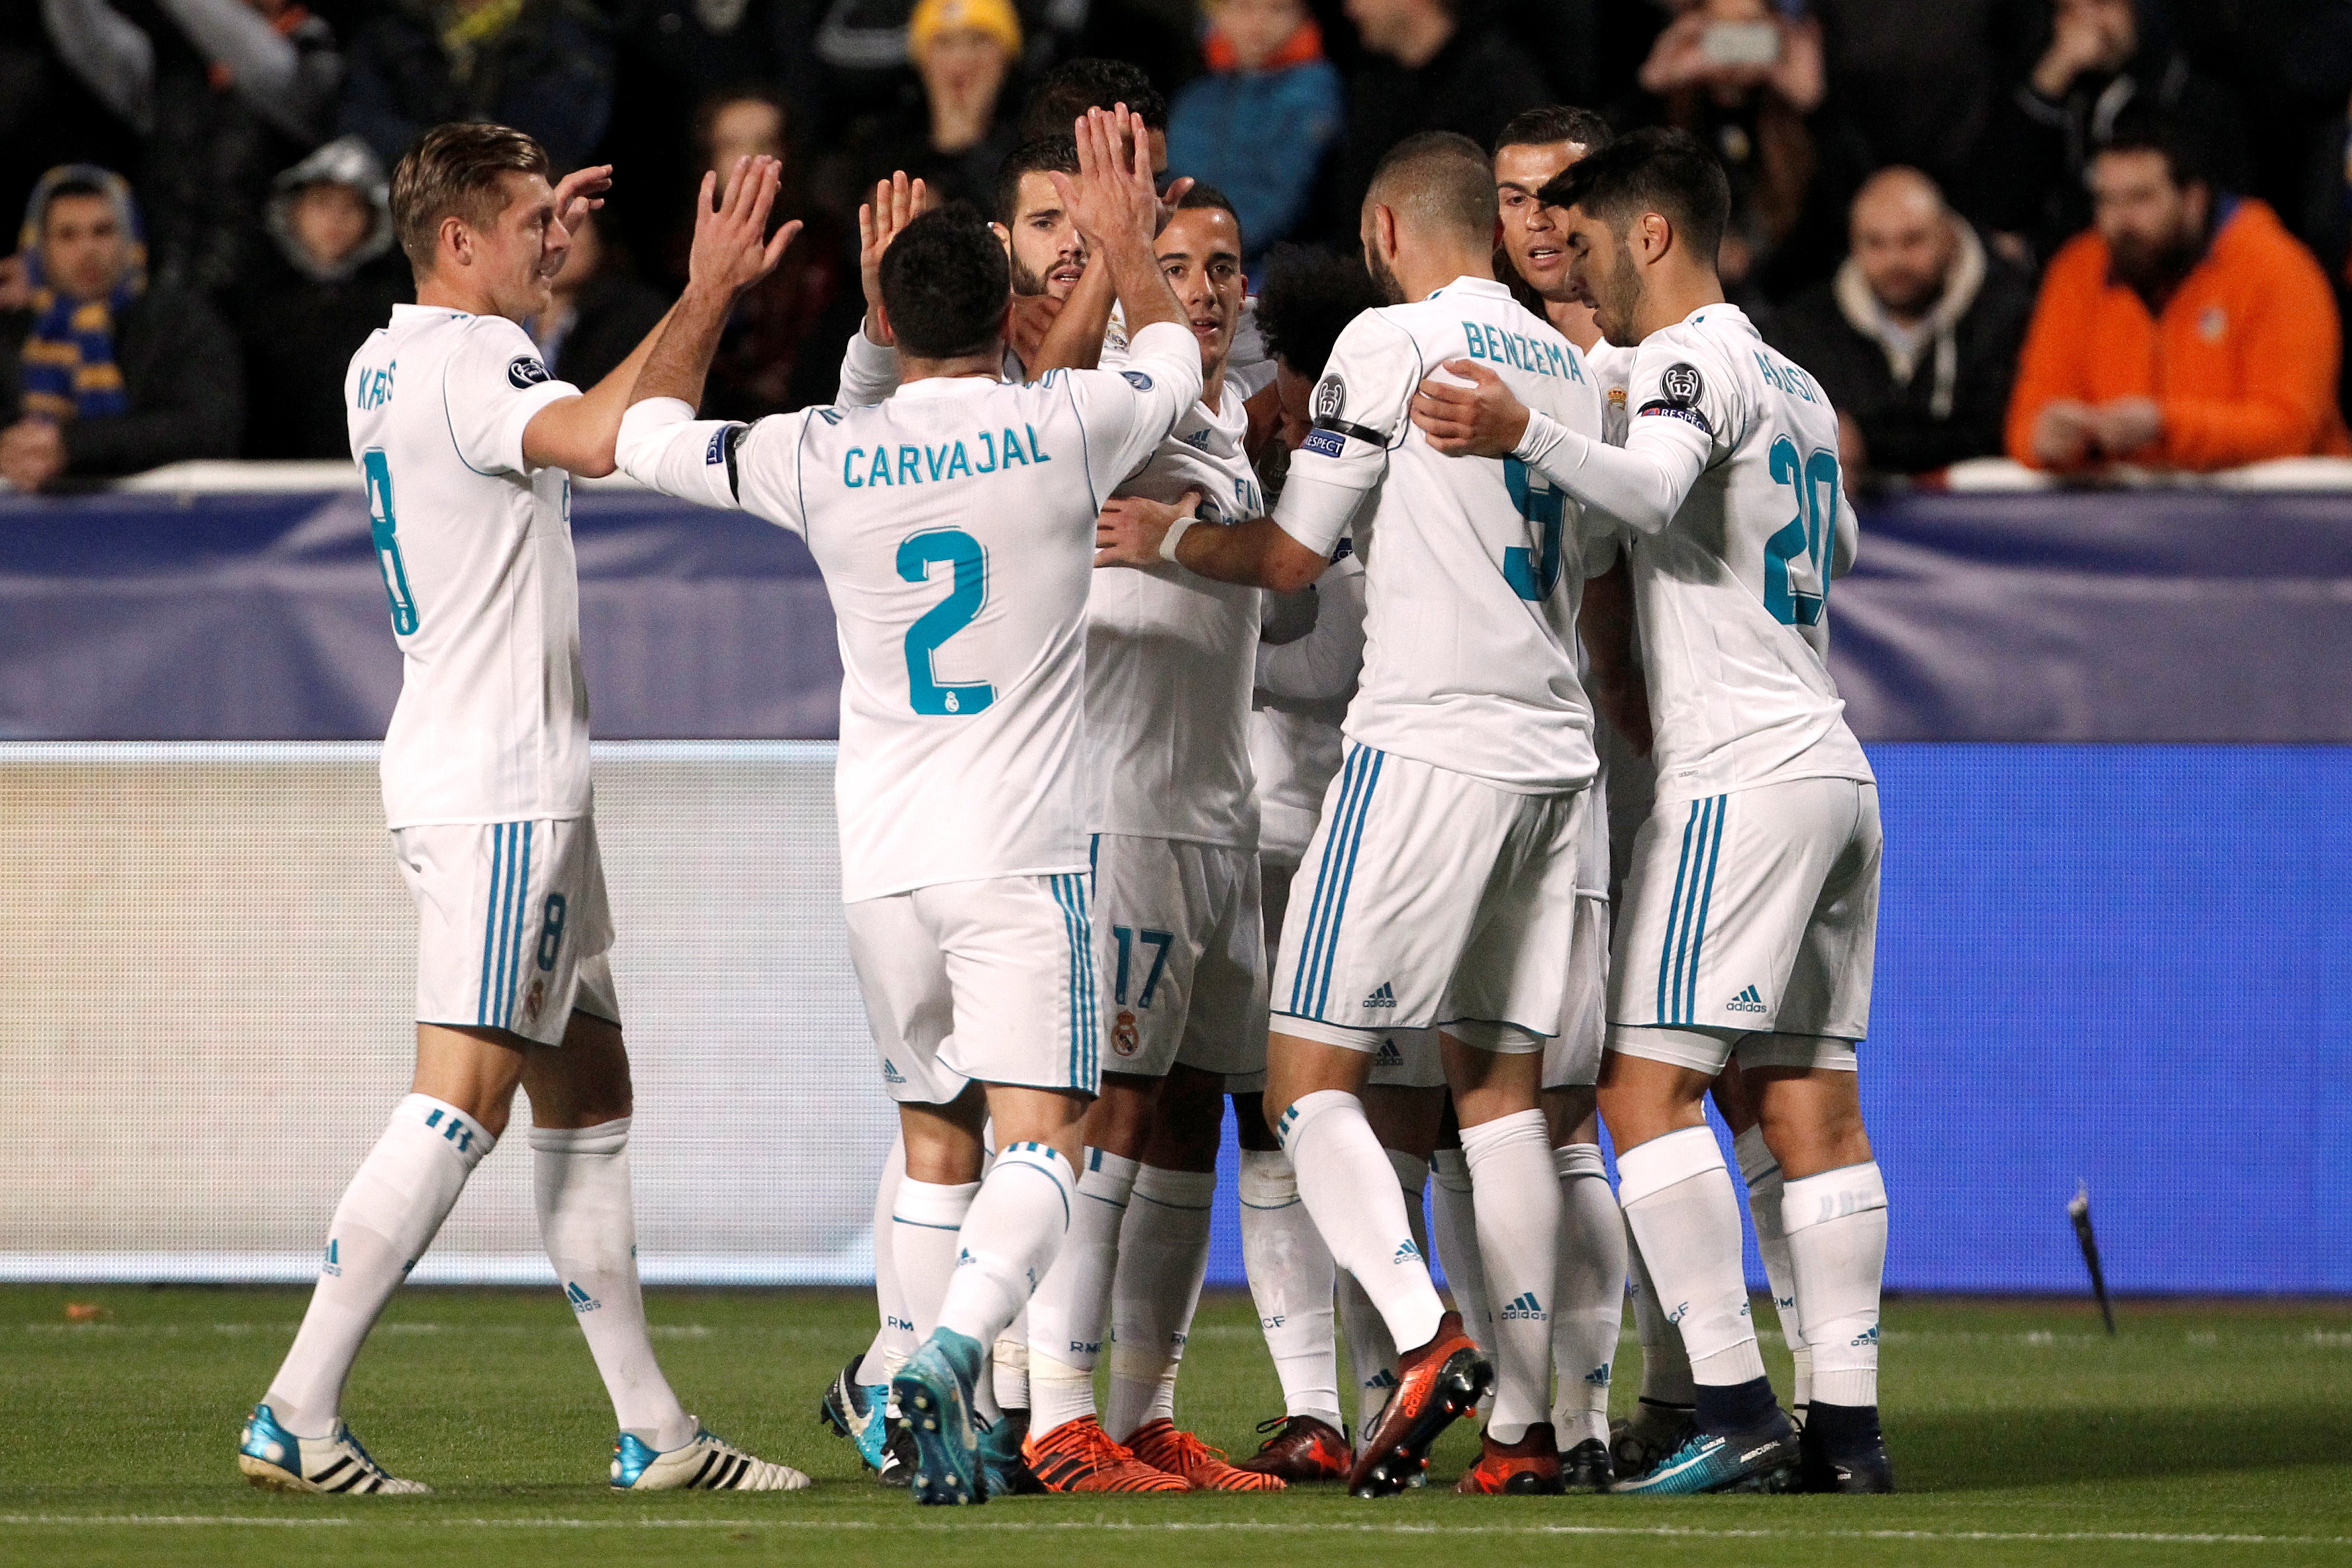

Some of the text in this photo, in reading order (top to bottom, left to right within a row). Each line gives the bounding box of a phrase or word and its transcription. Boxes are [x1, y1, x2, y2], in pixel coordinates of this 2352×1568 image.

[1461, 320, 1586, 385] BENZEMA
[1321, 400, 1334, 416] 12
[1674, 383, 1692, 396] 12
[844, 423, 1051, 488] CARVAJAL
[364, 447, 419, 636] 8
[1503, 452, 1567, 601] 9
[1764, 433, 1838, 626] 20
[896, 525, 998, 715] 2
[537, 893, 566, 972] 8
[1113, 924, 1174, 1008] 17
[1363, 999, 1397, 1008] adidas
[1726, 1001, 1767, 1013] adidas
[888, 1316, 914, 1331] RM
[1502, 1310, 1547, 1321] adidas
[1740, 1440, 1781, 1463] MERCURIAL
